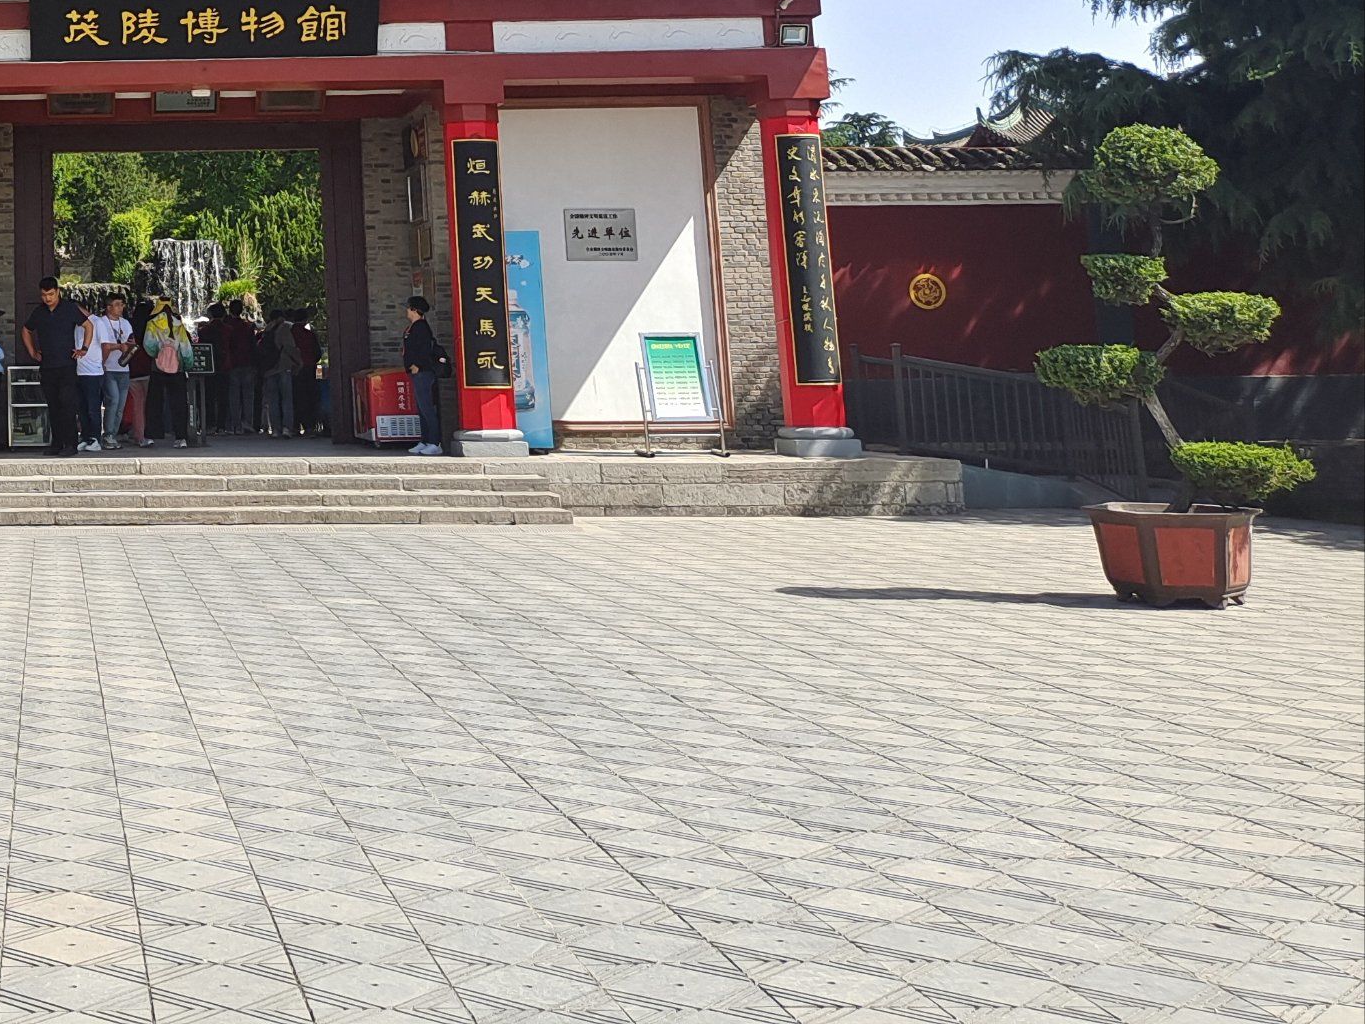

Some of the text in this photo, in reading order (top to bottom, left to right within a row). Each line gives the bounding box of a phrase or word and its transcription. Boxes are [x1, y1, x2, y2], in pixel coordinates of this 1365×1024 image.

[64, 4, 347, 46] 茂陵博物館
